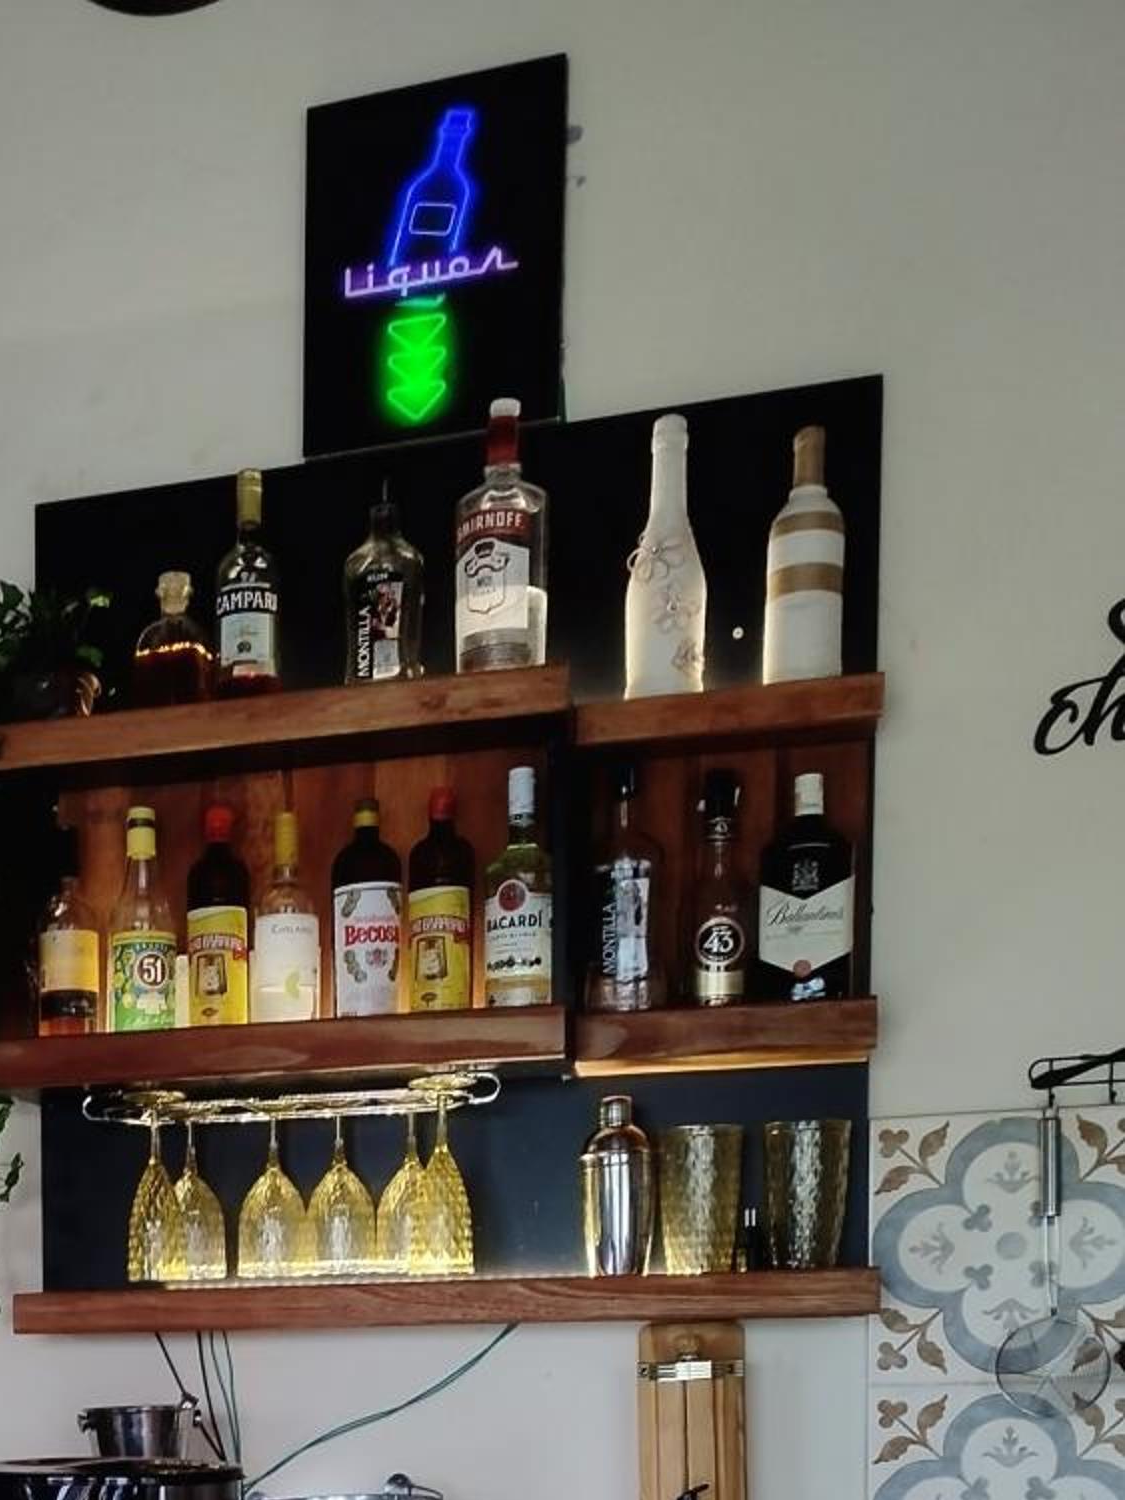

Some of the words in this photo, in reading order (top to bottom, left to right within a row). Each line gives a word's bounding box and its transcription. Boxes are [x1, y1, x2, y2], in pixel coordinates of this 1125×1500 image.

[344, 246, 519, 298] Liquor
[457, 511, 524, 544] SMIRNOFF
[216, 591, 278, 616] CAMPARI
[357, 605, 371, 677] MONTILLA
[703, 929, 734, 953] 43
[142, 957, 162, 983] 51
